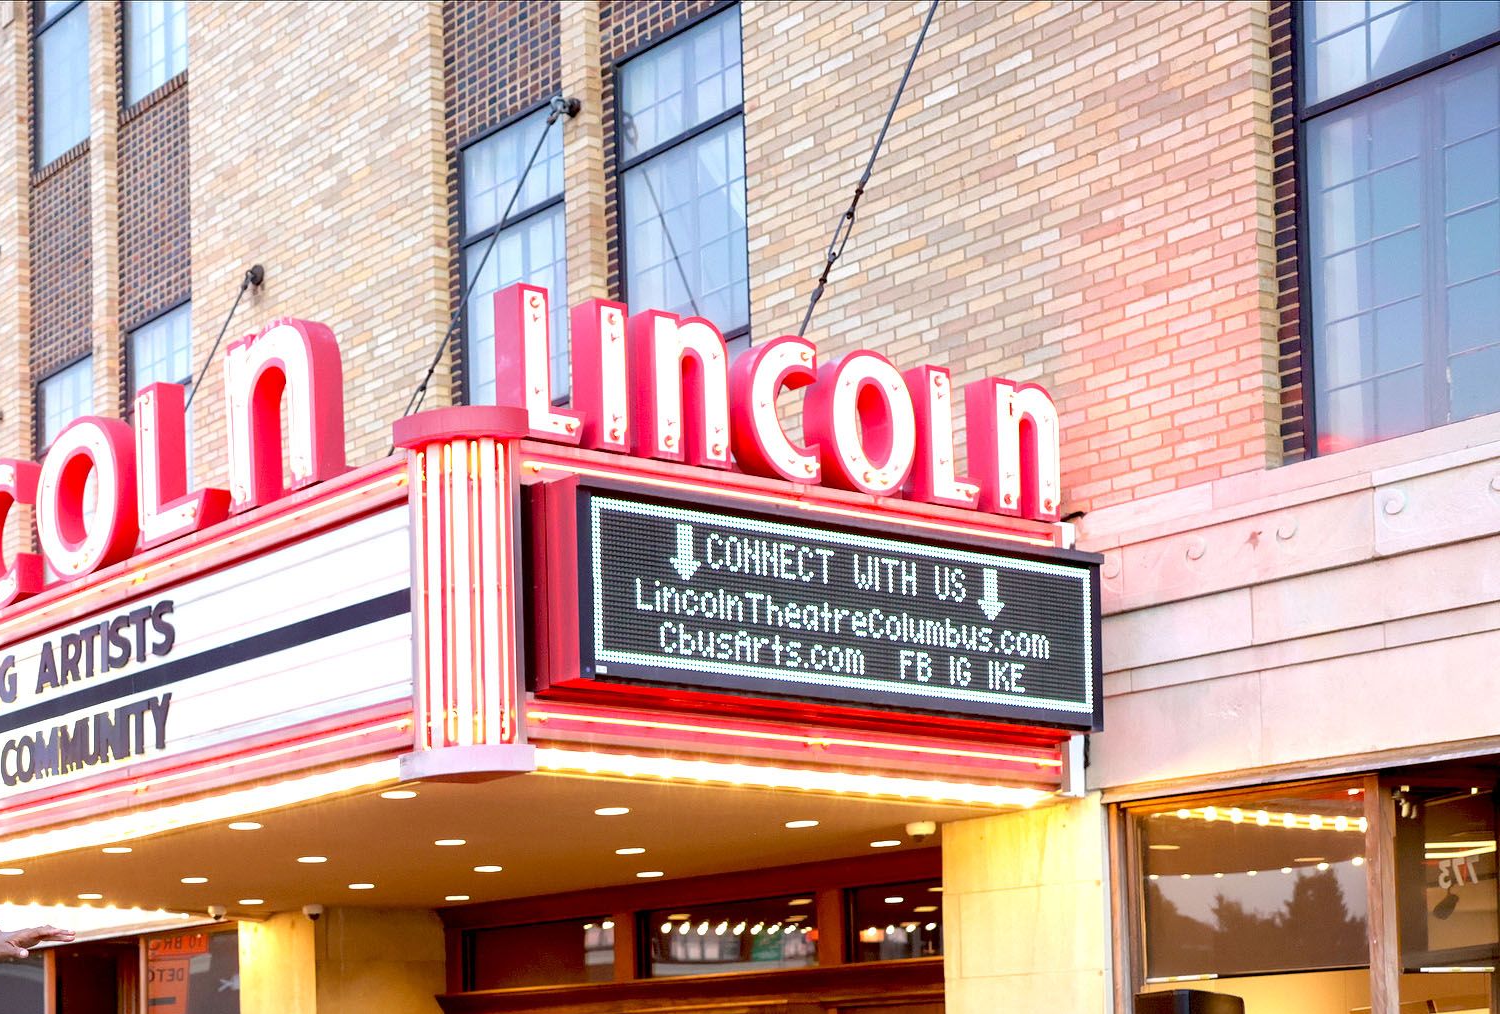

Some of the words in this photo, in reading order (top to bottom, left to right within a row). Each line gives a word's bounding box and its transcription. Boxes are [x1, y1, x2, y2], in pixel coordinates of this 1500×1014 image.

[494, 282, 1060, 522] LINCOLN
[707, 533, 834, 584] CONNECT
[854, 554, 916, 596] WITH
[934, 565, 966, 602] US
[35, 600, 176, 694] ARTISTS
[635, 577, 1049, 660] LincolnTheatreColumbus.com
[660, 621, 865, 676] CbusArts.com
[900, 650, 932, 682] FB
[950, 655, 971, 687] IG
[988, 660, 1026, 693] IKE
[0, 692, 172, 786] COMMUNITY
